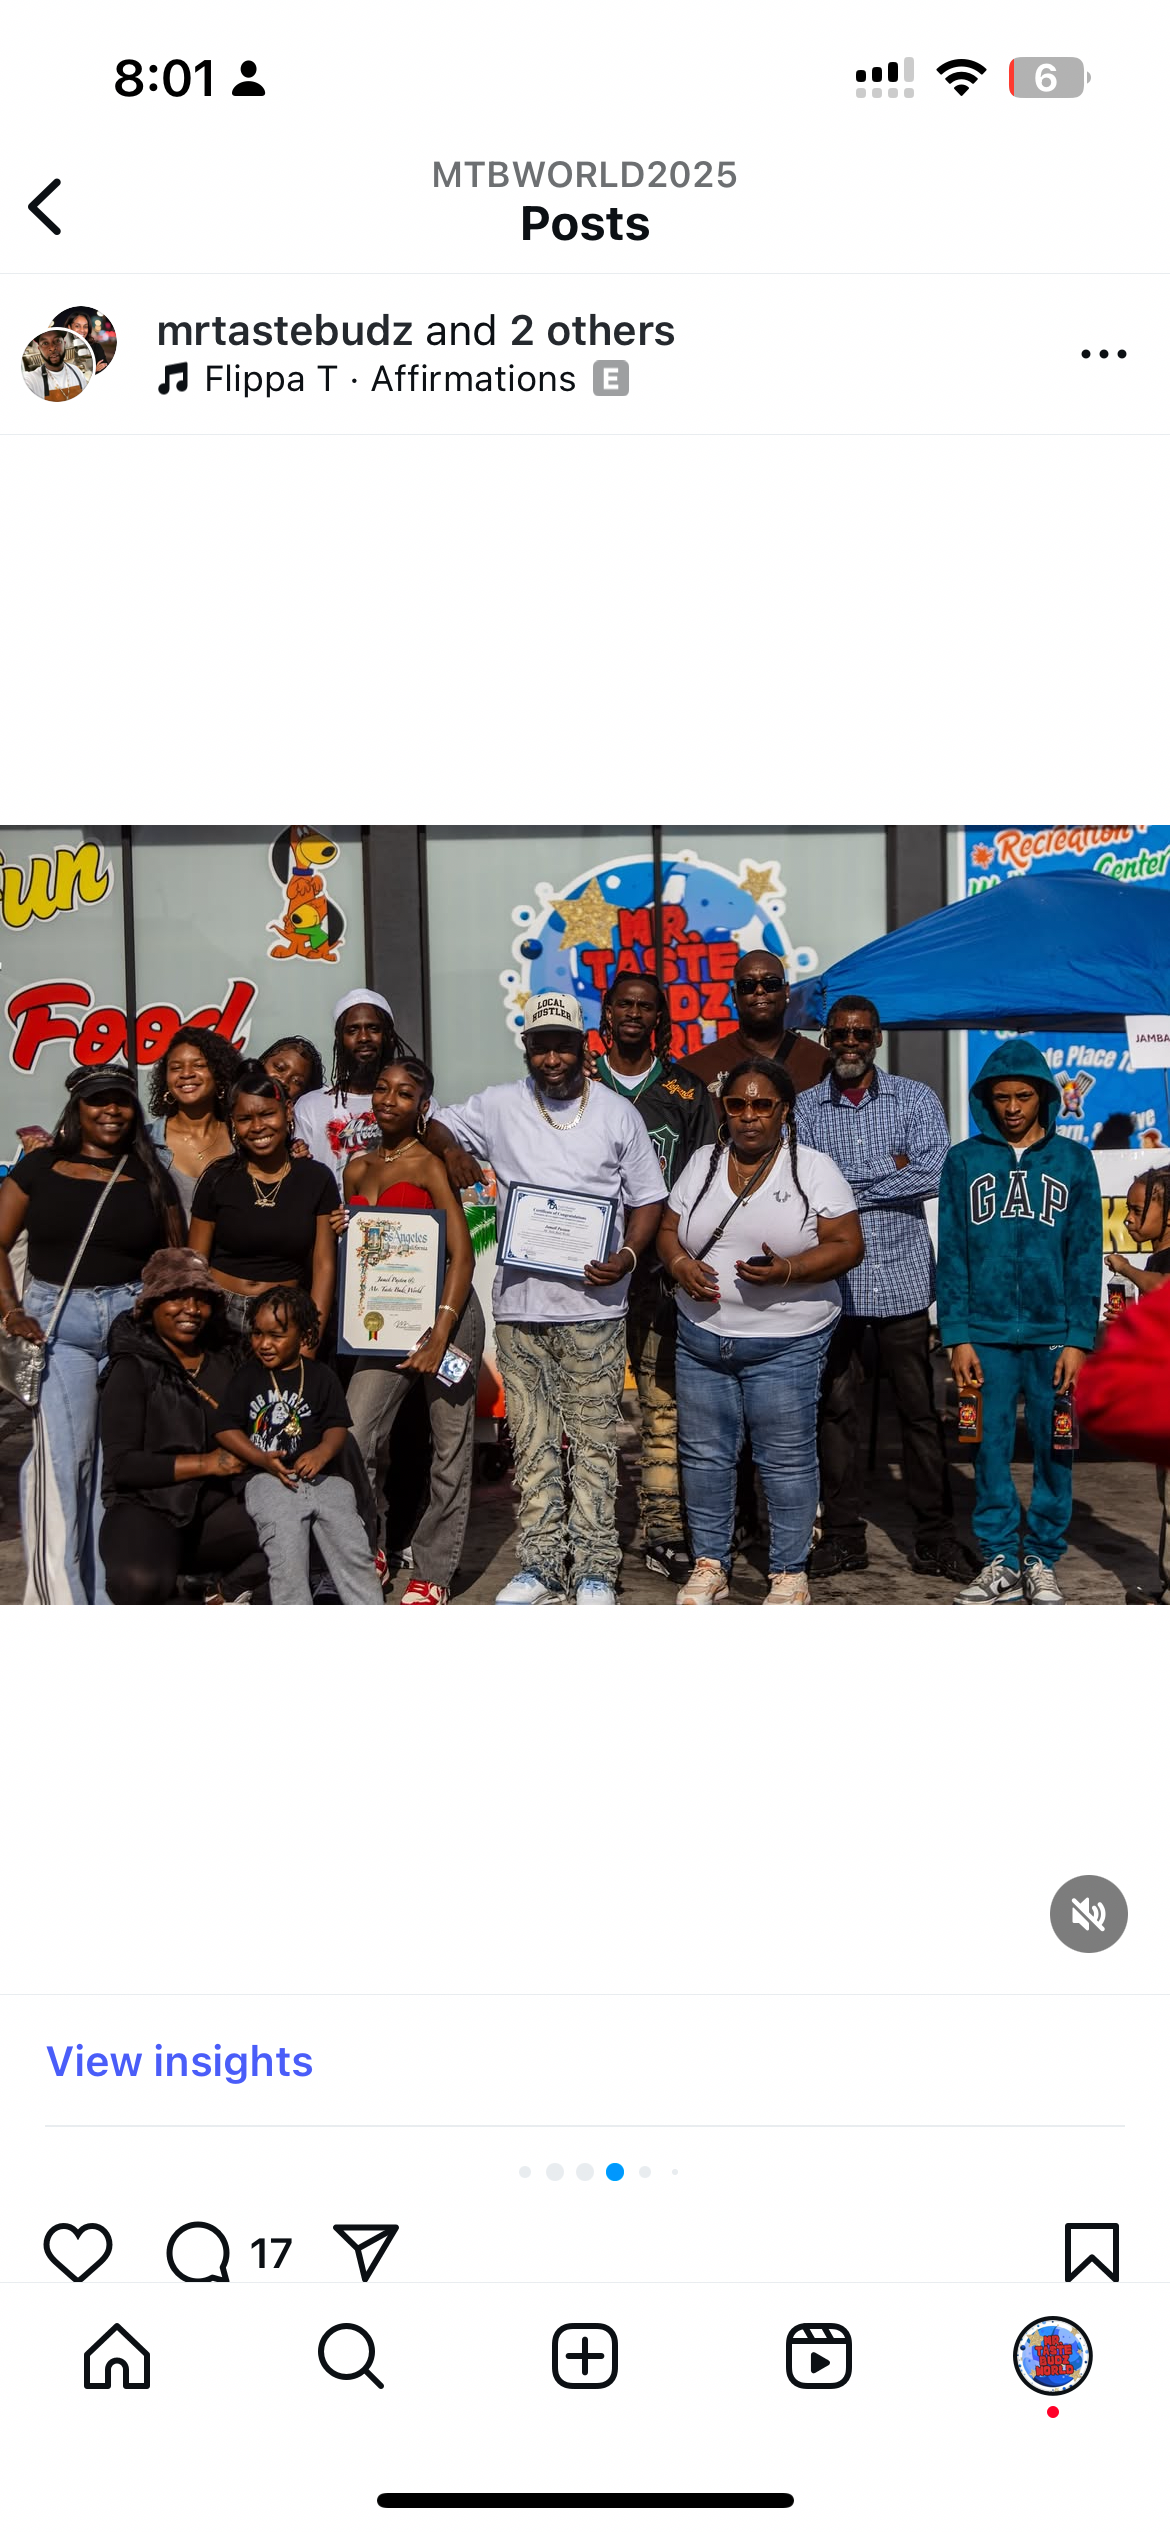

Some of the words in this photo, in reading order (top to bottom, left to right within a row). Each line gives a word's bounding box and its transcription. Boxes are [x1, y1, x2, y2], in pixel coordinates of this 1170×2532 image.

[996, 825, 1131, 868] Recreation
[0, 842, 110, 929] un
[618, 904, 702, 949] MR.
[532, 1007, 572, 1023] HUSTLER
[537, 998, 565, 1010] LOCAL
[8, 980, 256, 1071] Food
[1065, 1044, 1118, 1070] Place
[661, 1078, 696, 1101] Legends
[969, 1170, 1069, 1228] GAP
[394, 1231, 428, 1244] Angeles
[249, 1393, 266, 1419] BOB
[267, 1389, 313, 1418] MARLEY
